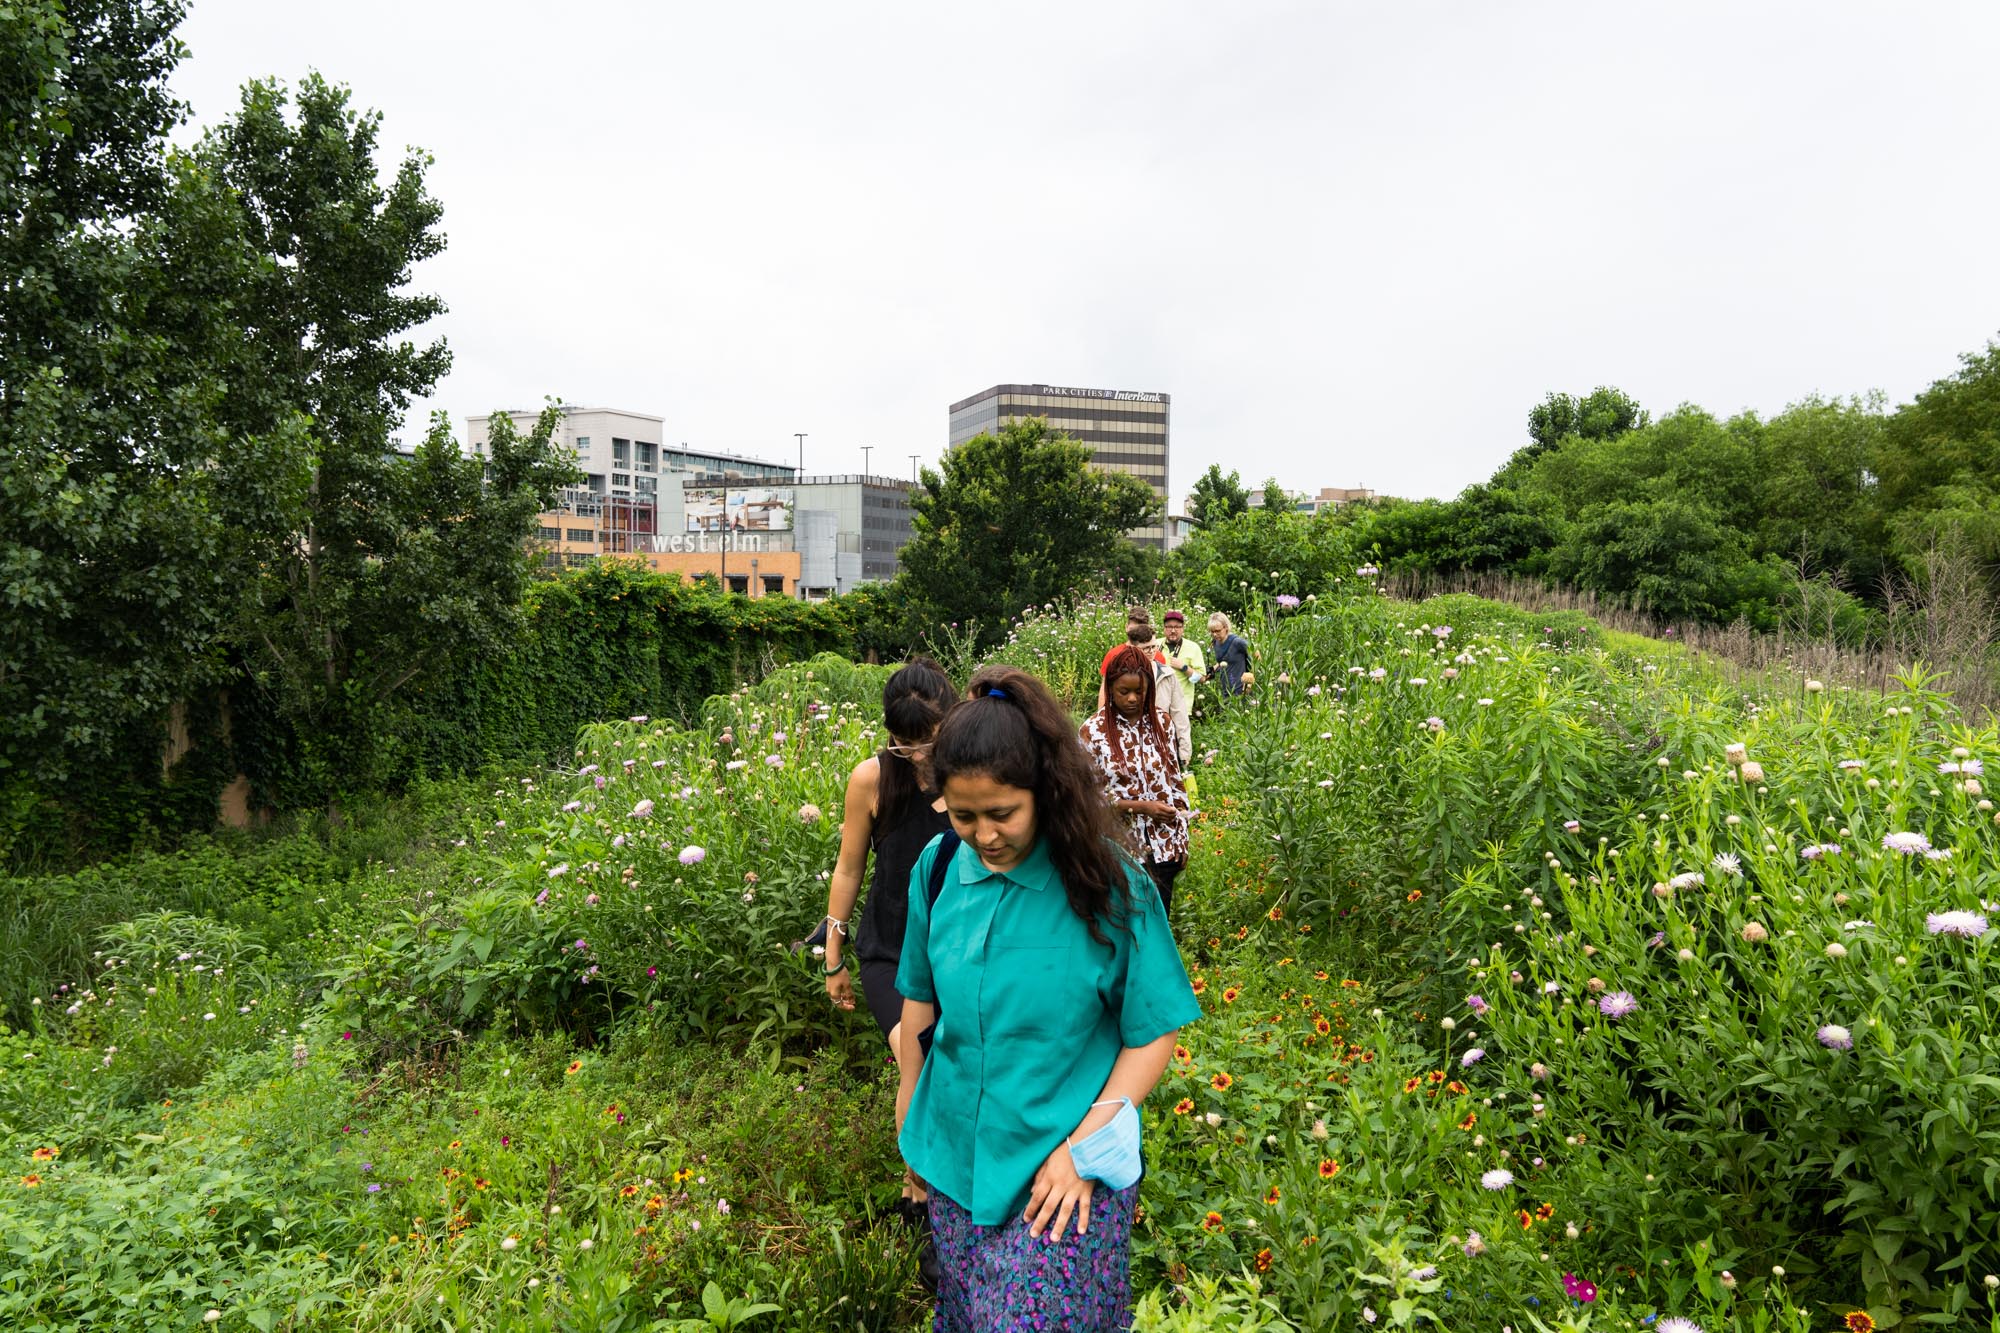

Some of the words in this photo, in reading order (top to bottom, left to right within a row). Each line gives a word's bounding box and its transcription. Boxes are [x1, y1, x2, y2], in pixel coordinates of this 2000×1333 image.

[1043, 387, 1068, 395] PARK
[1070, 389, 1103, 397] CITIES
[1114, 390, 1161, 402] InterBank
[652, 529, 708, 553] west
[718, 529, 761, 552] elm
